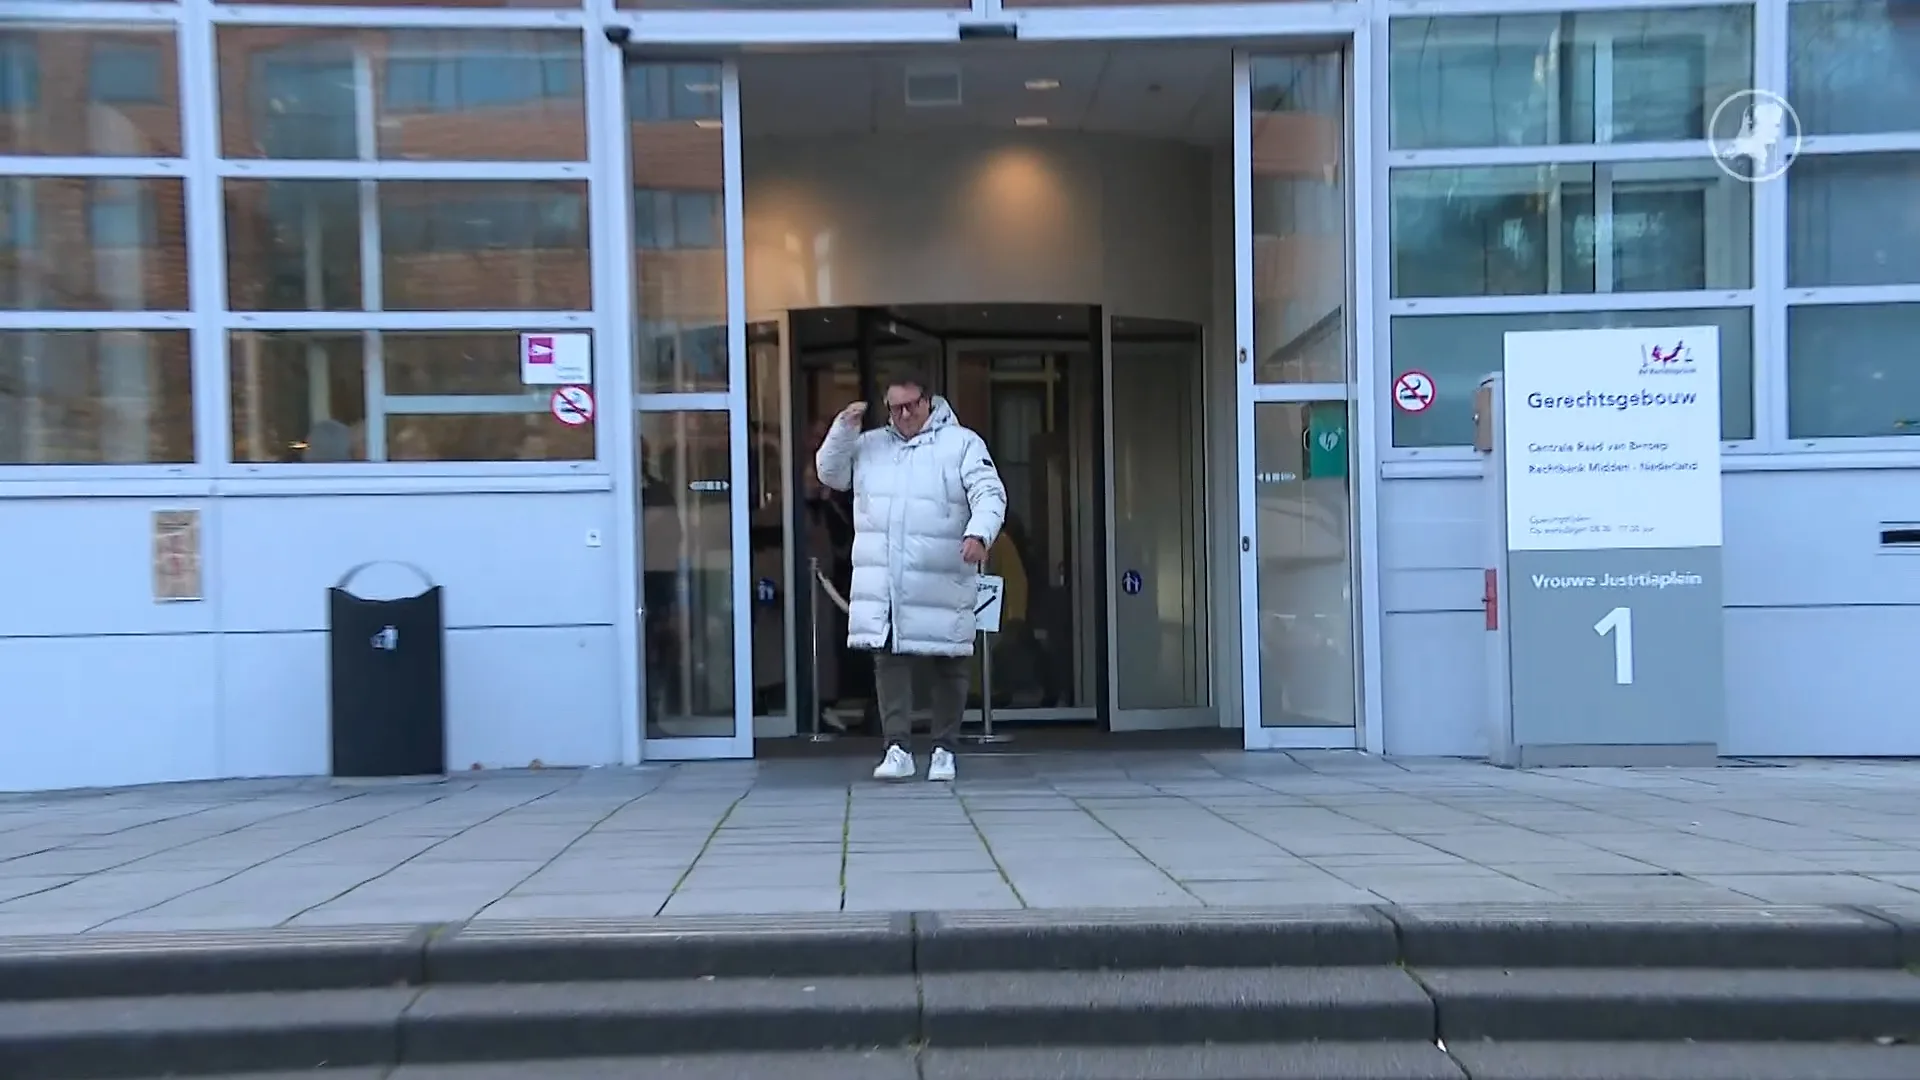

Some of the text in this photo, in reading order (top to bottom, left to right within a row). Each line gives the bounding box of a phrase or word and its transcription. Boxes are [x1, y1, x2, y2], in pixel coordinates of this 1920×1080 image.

[1527, 388, 1697, 411] Gerechtsgebouw
[1531, 573, 1596, 589] Vrouwe
[1593, 606, 1633, 685] 1
